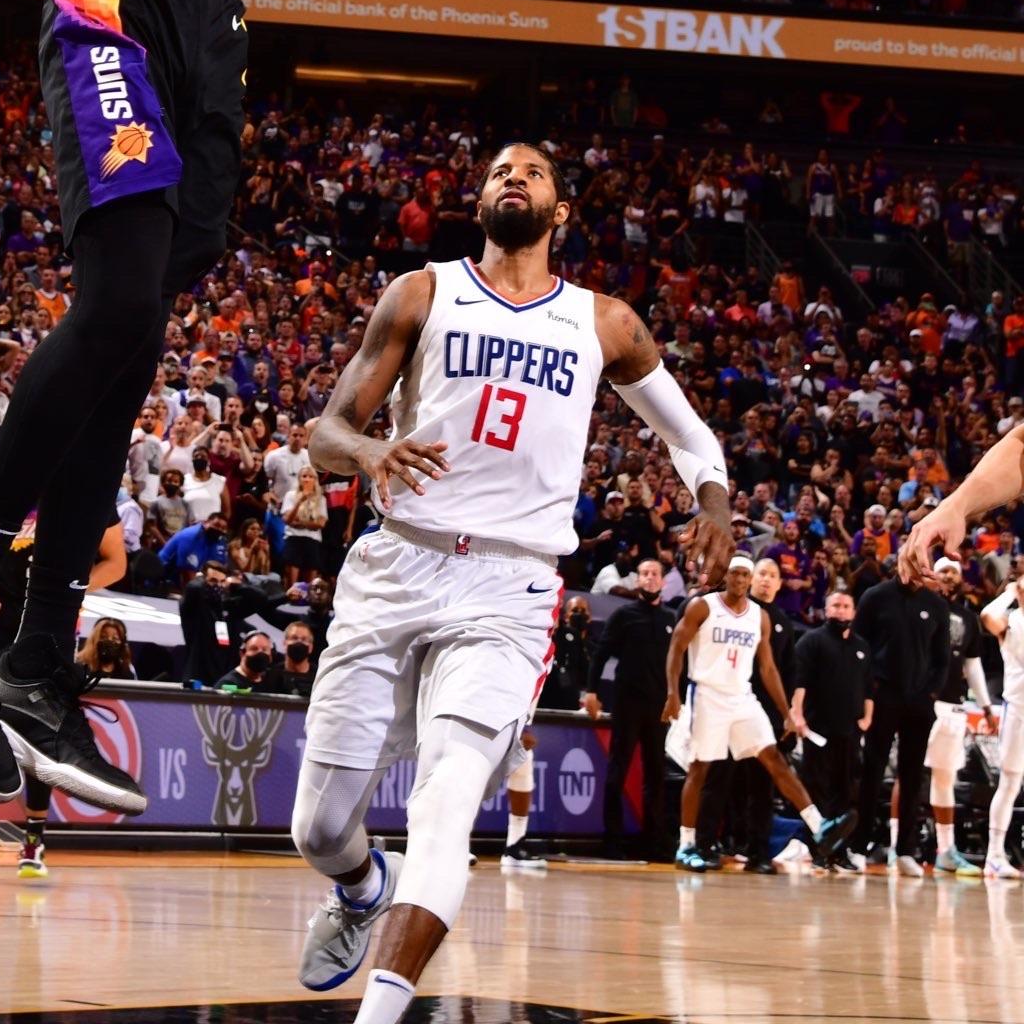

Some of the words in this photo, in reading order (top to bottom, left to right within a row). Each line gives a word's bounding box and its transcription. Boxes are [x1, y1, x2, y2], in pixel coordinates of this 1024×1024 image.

[345, 0, 386, 18] bank
[390, 4, 408, 20] of
[410, 5, 438, 23] the
[442, 7, 505, 27] Phoenix
[509, 10, 548, 30] Suns
[597, 6, 786, 58] 1STBANK
[834, 36, 882, 55] proud
[887, 38, 904, 55] to
[908, 39, 927, 57] be
[931, 41, 958, 59] the
[962, 42, 1014, 63] official
[90, 46, 133, 120] SUNS
[546, 310, 581, 330] honey
[444, 330, 579, 397] CLIPPERS
[471, 383, 527, 452] 13
[727, 648, 738, 669] 4
[158, 747, 188, 800] VS
